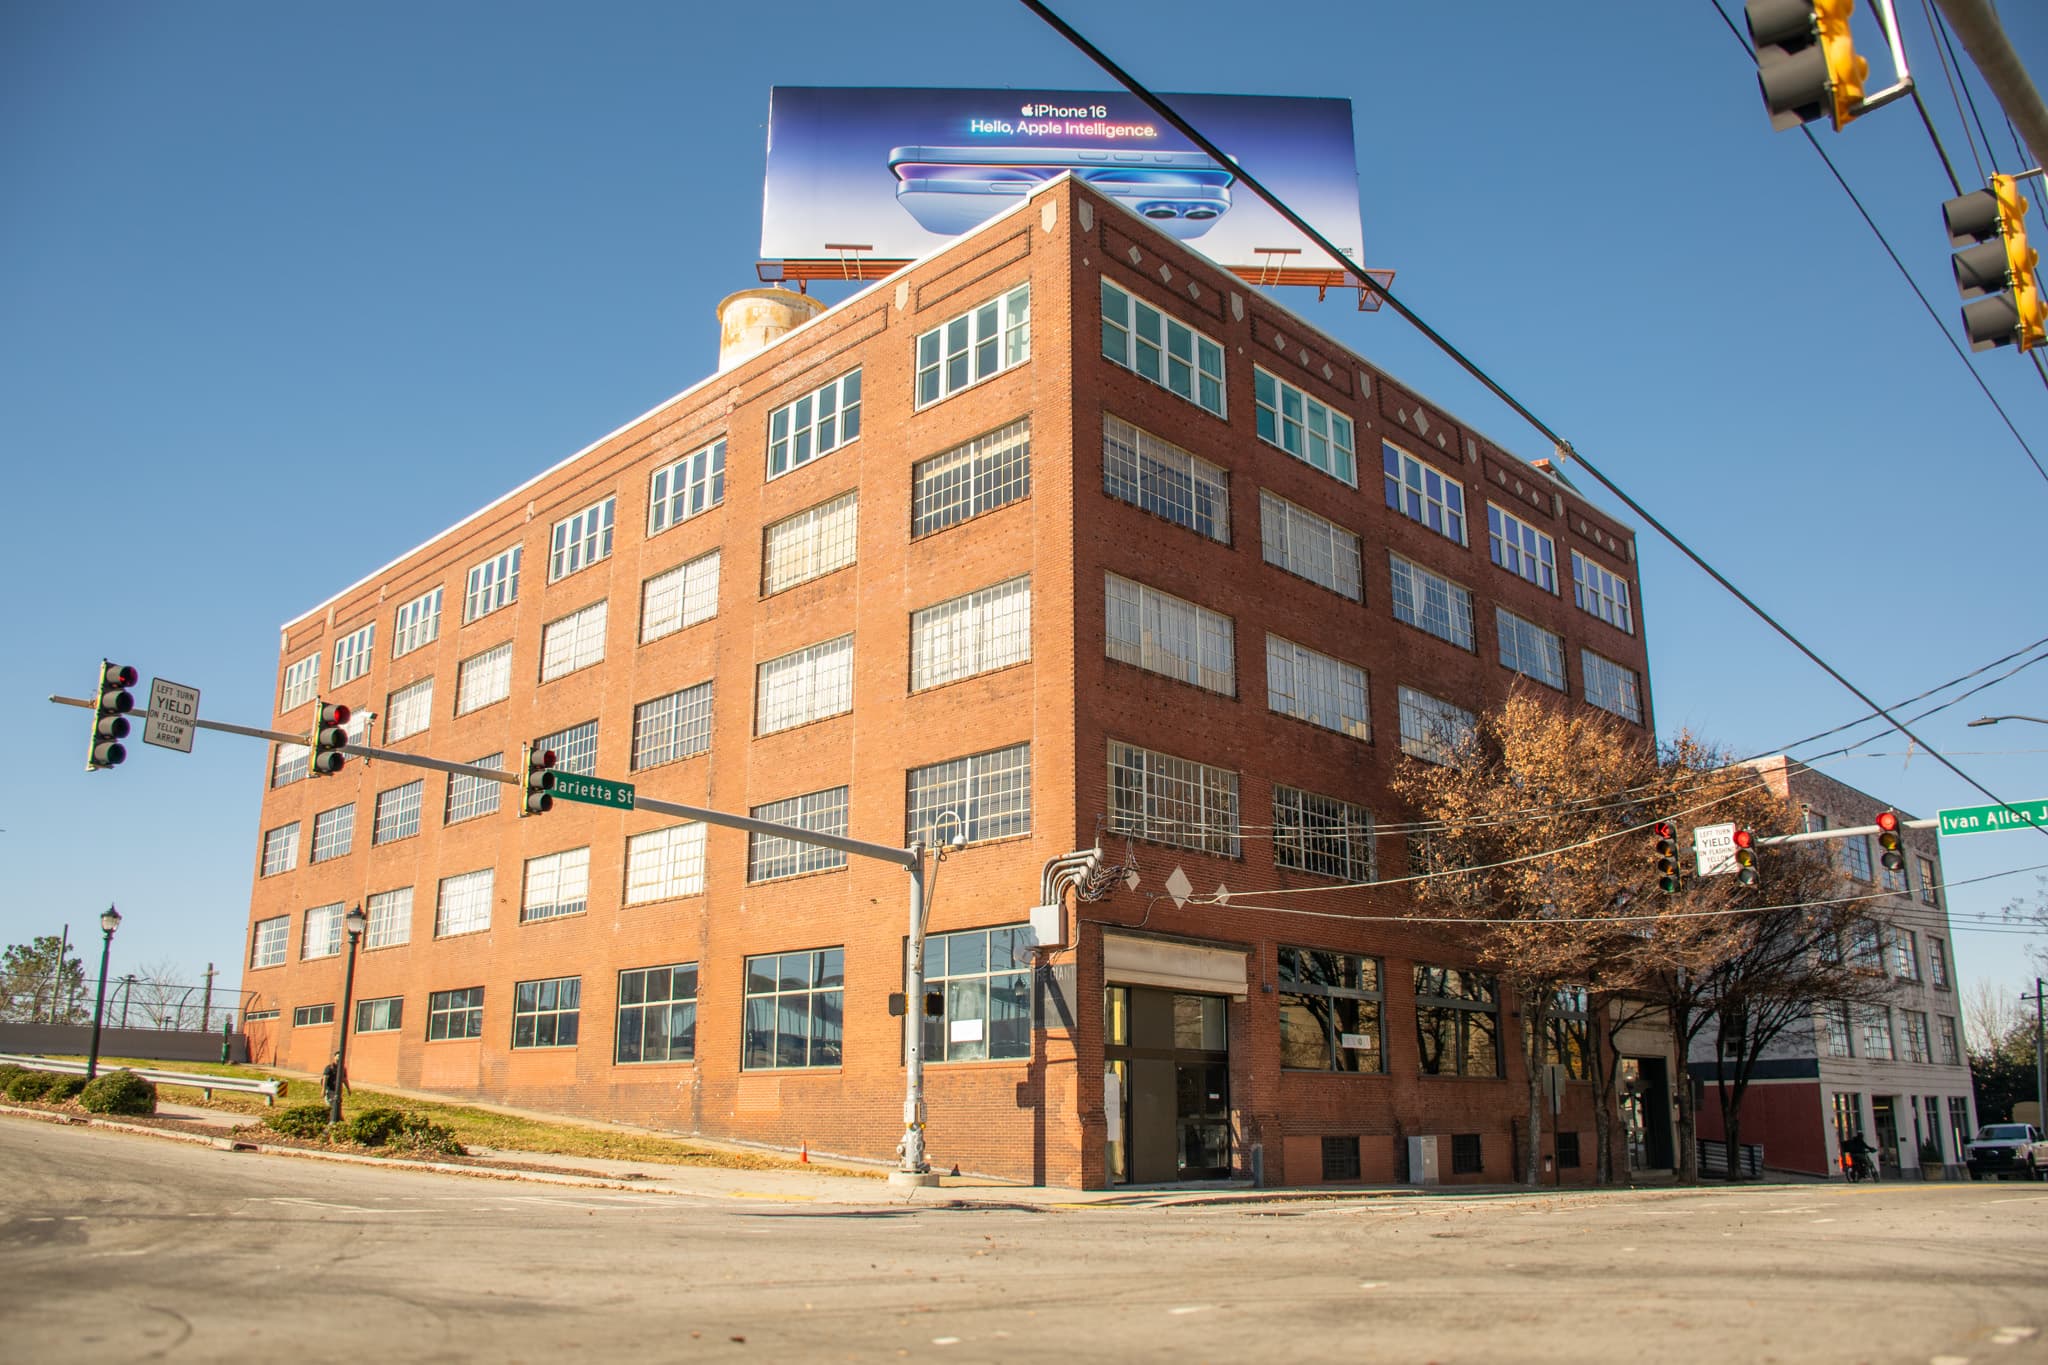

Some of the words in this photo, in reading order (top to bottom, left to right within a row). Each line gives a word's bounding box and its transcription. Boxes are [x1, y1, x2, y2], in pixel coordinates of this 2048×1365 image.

[1034, 104, 1088, 118] iPhone
[1089, 105, 1107, 118] 16
[971, 120, 1014, 135] Hello,
[1017, 121, 1062, 136] Apple
[1065, 122, 1158, 138] Intelligence.
[156, 684, 173, 696] LEFT
[176, 690, 195, 701] TURN
[157, 696, 192, 715] YIELD
[149, 709, 159, 718] ON
[162, 712, 197, 728] FLASHING
[157, 722, 184, 735] YELLOW
[157, 732, 181, 745] ARROW
[617, 788, 633, 804] St
[1943, 815, 1980, 830] Ivan
[1986, 810, 2032, 825] Allen
[1702, 836, 1731, 848] YIELD
